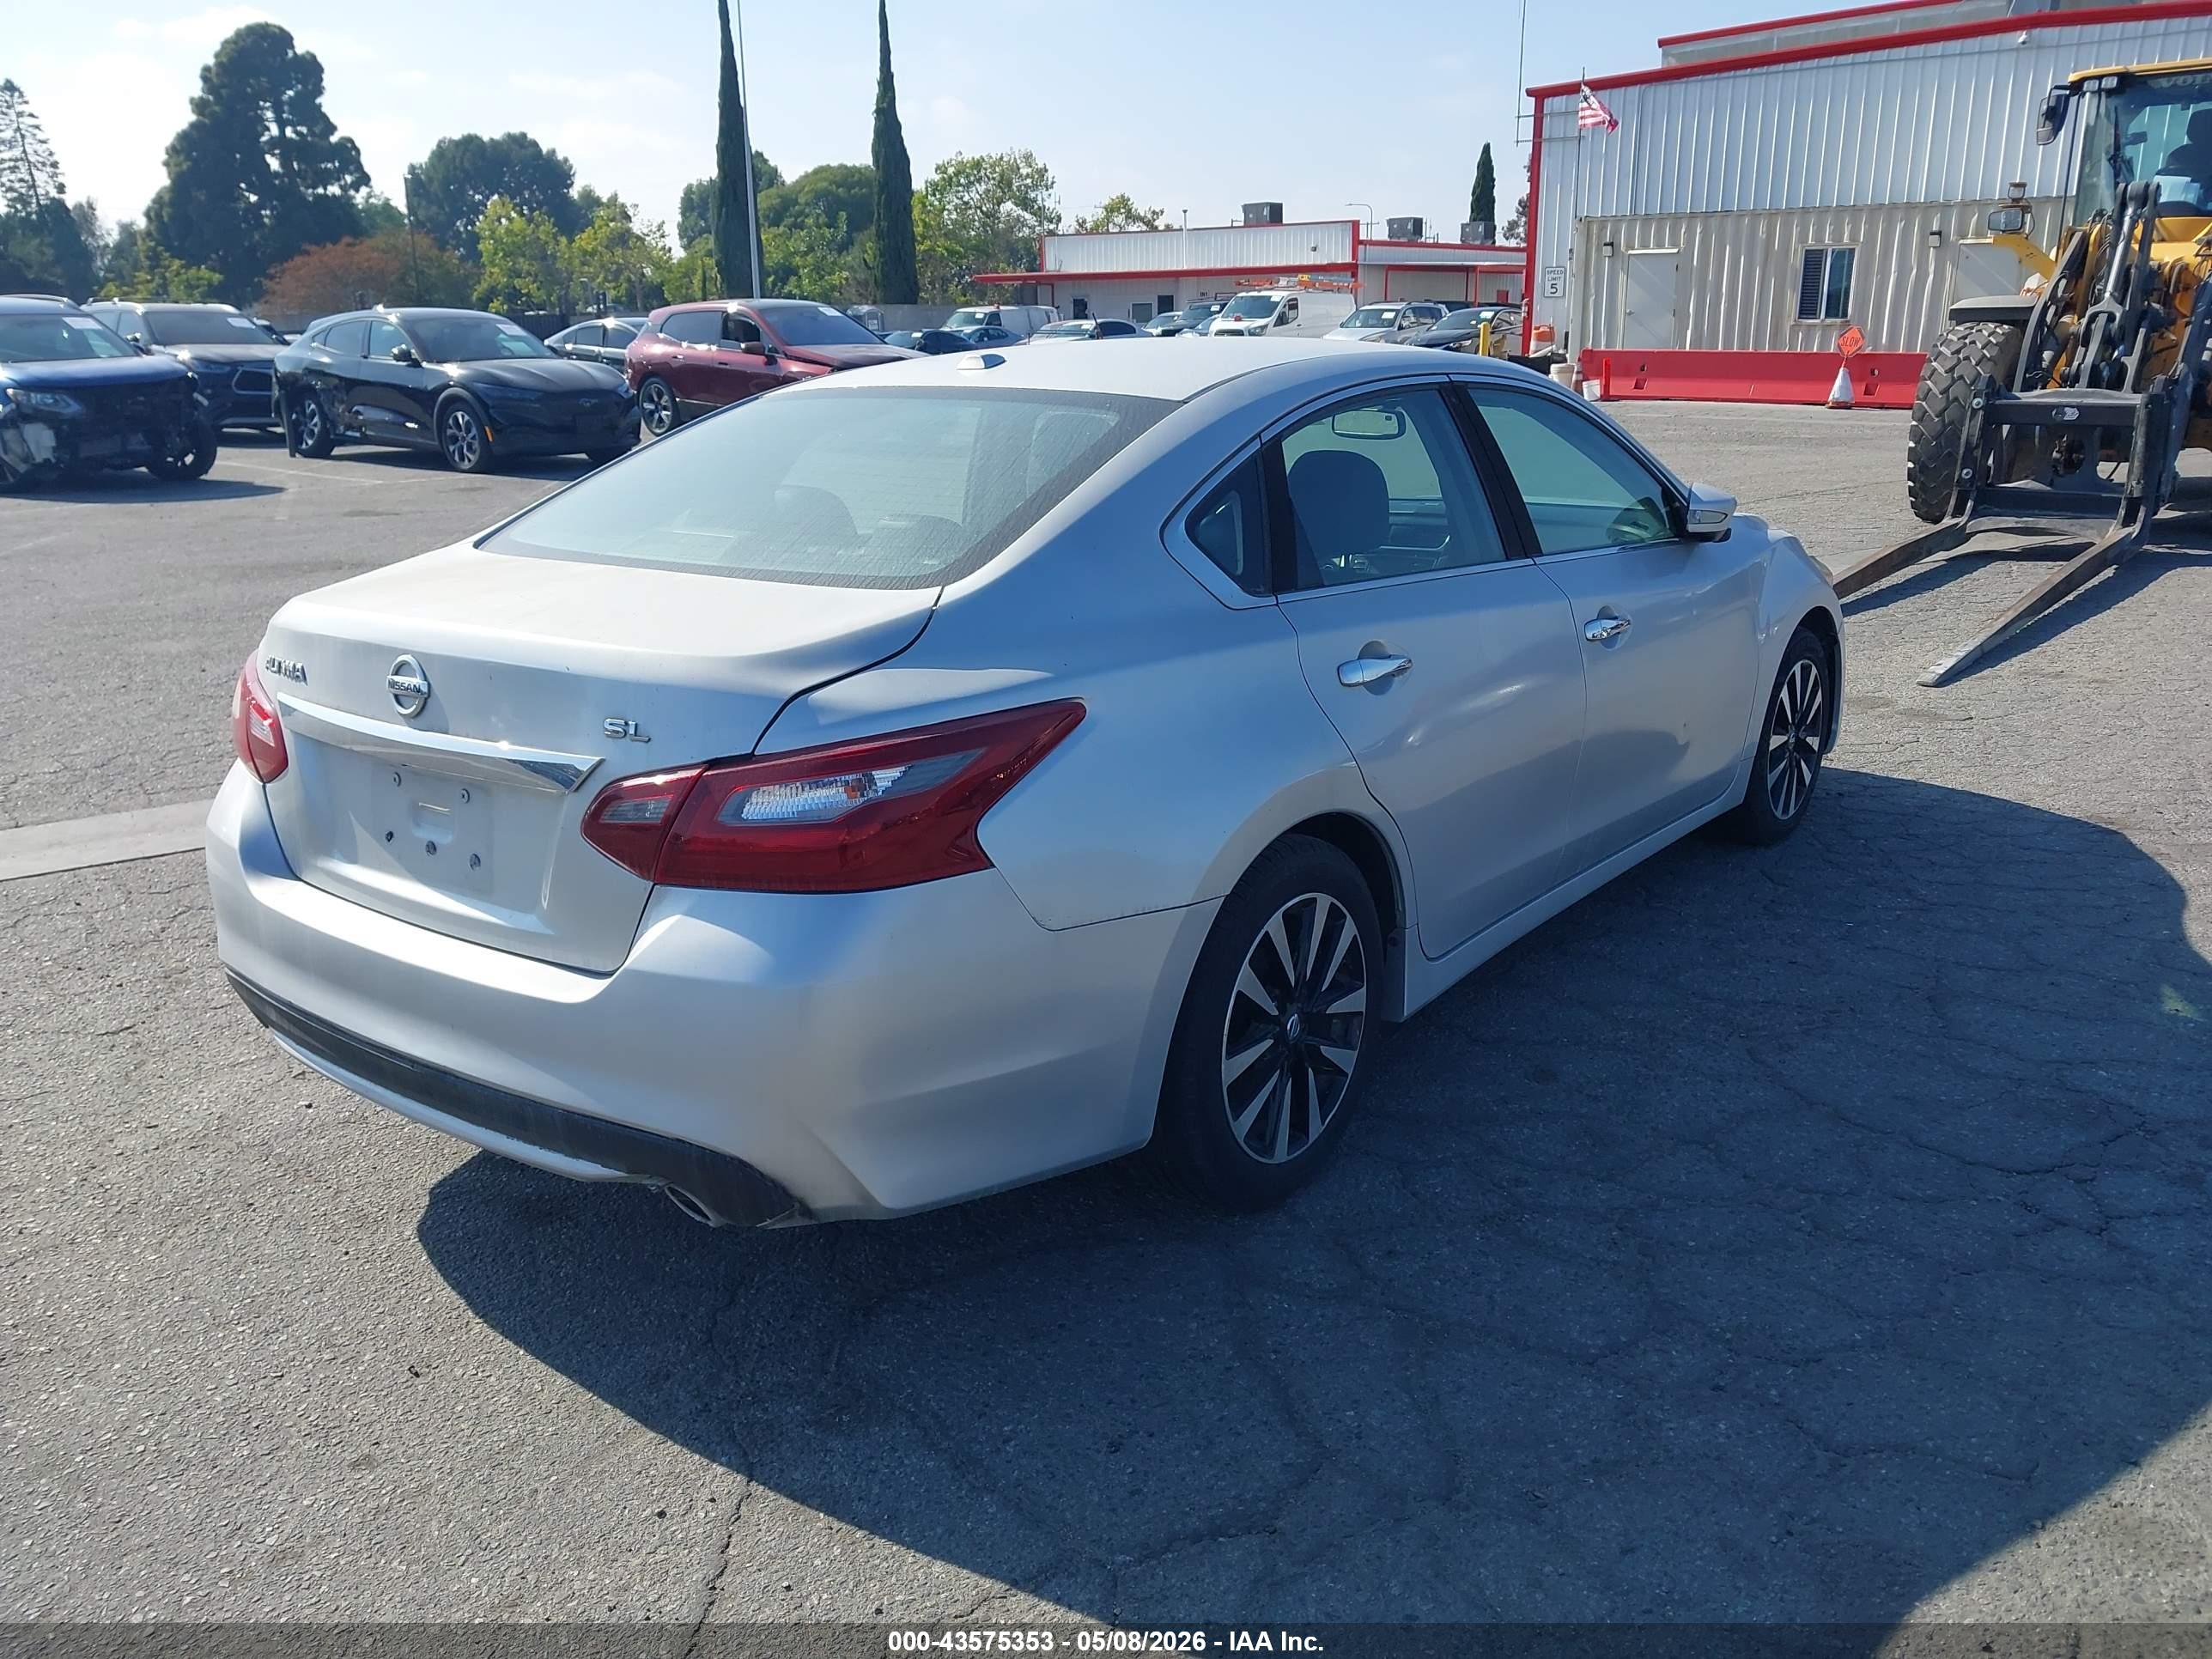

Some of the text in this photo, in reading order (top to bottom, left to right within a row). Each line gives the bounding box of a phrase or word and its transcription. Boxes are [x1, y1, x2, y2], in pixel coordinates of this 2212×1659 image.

[2159, 73, 2212, 88] VOL
[1550, 283, 1559, 295] 5
[1840, 336, 1861, 347] SLOW
[387, 678, 421, 693] NISSAN
[604, 718, 652, 743] SL
